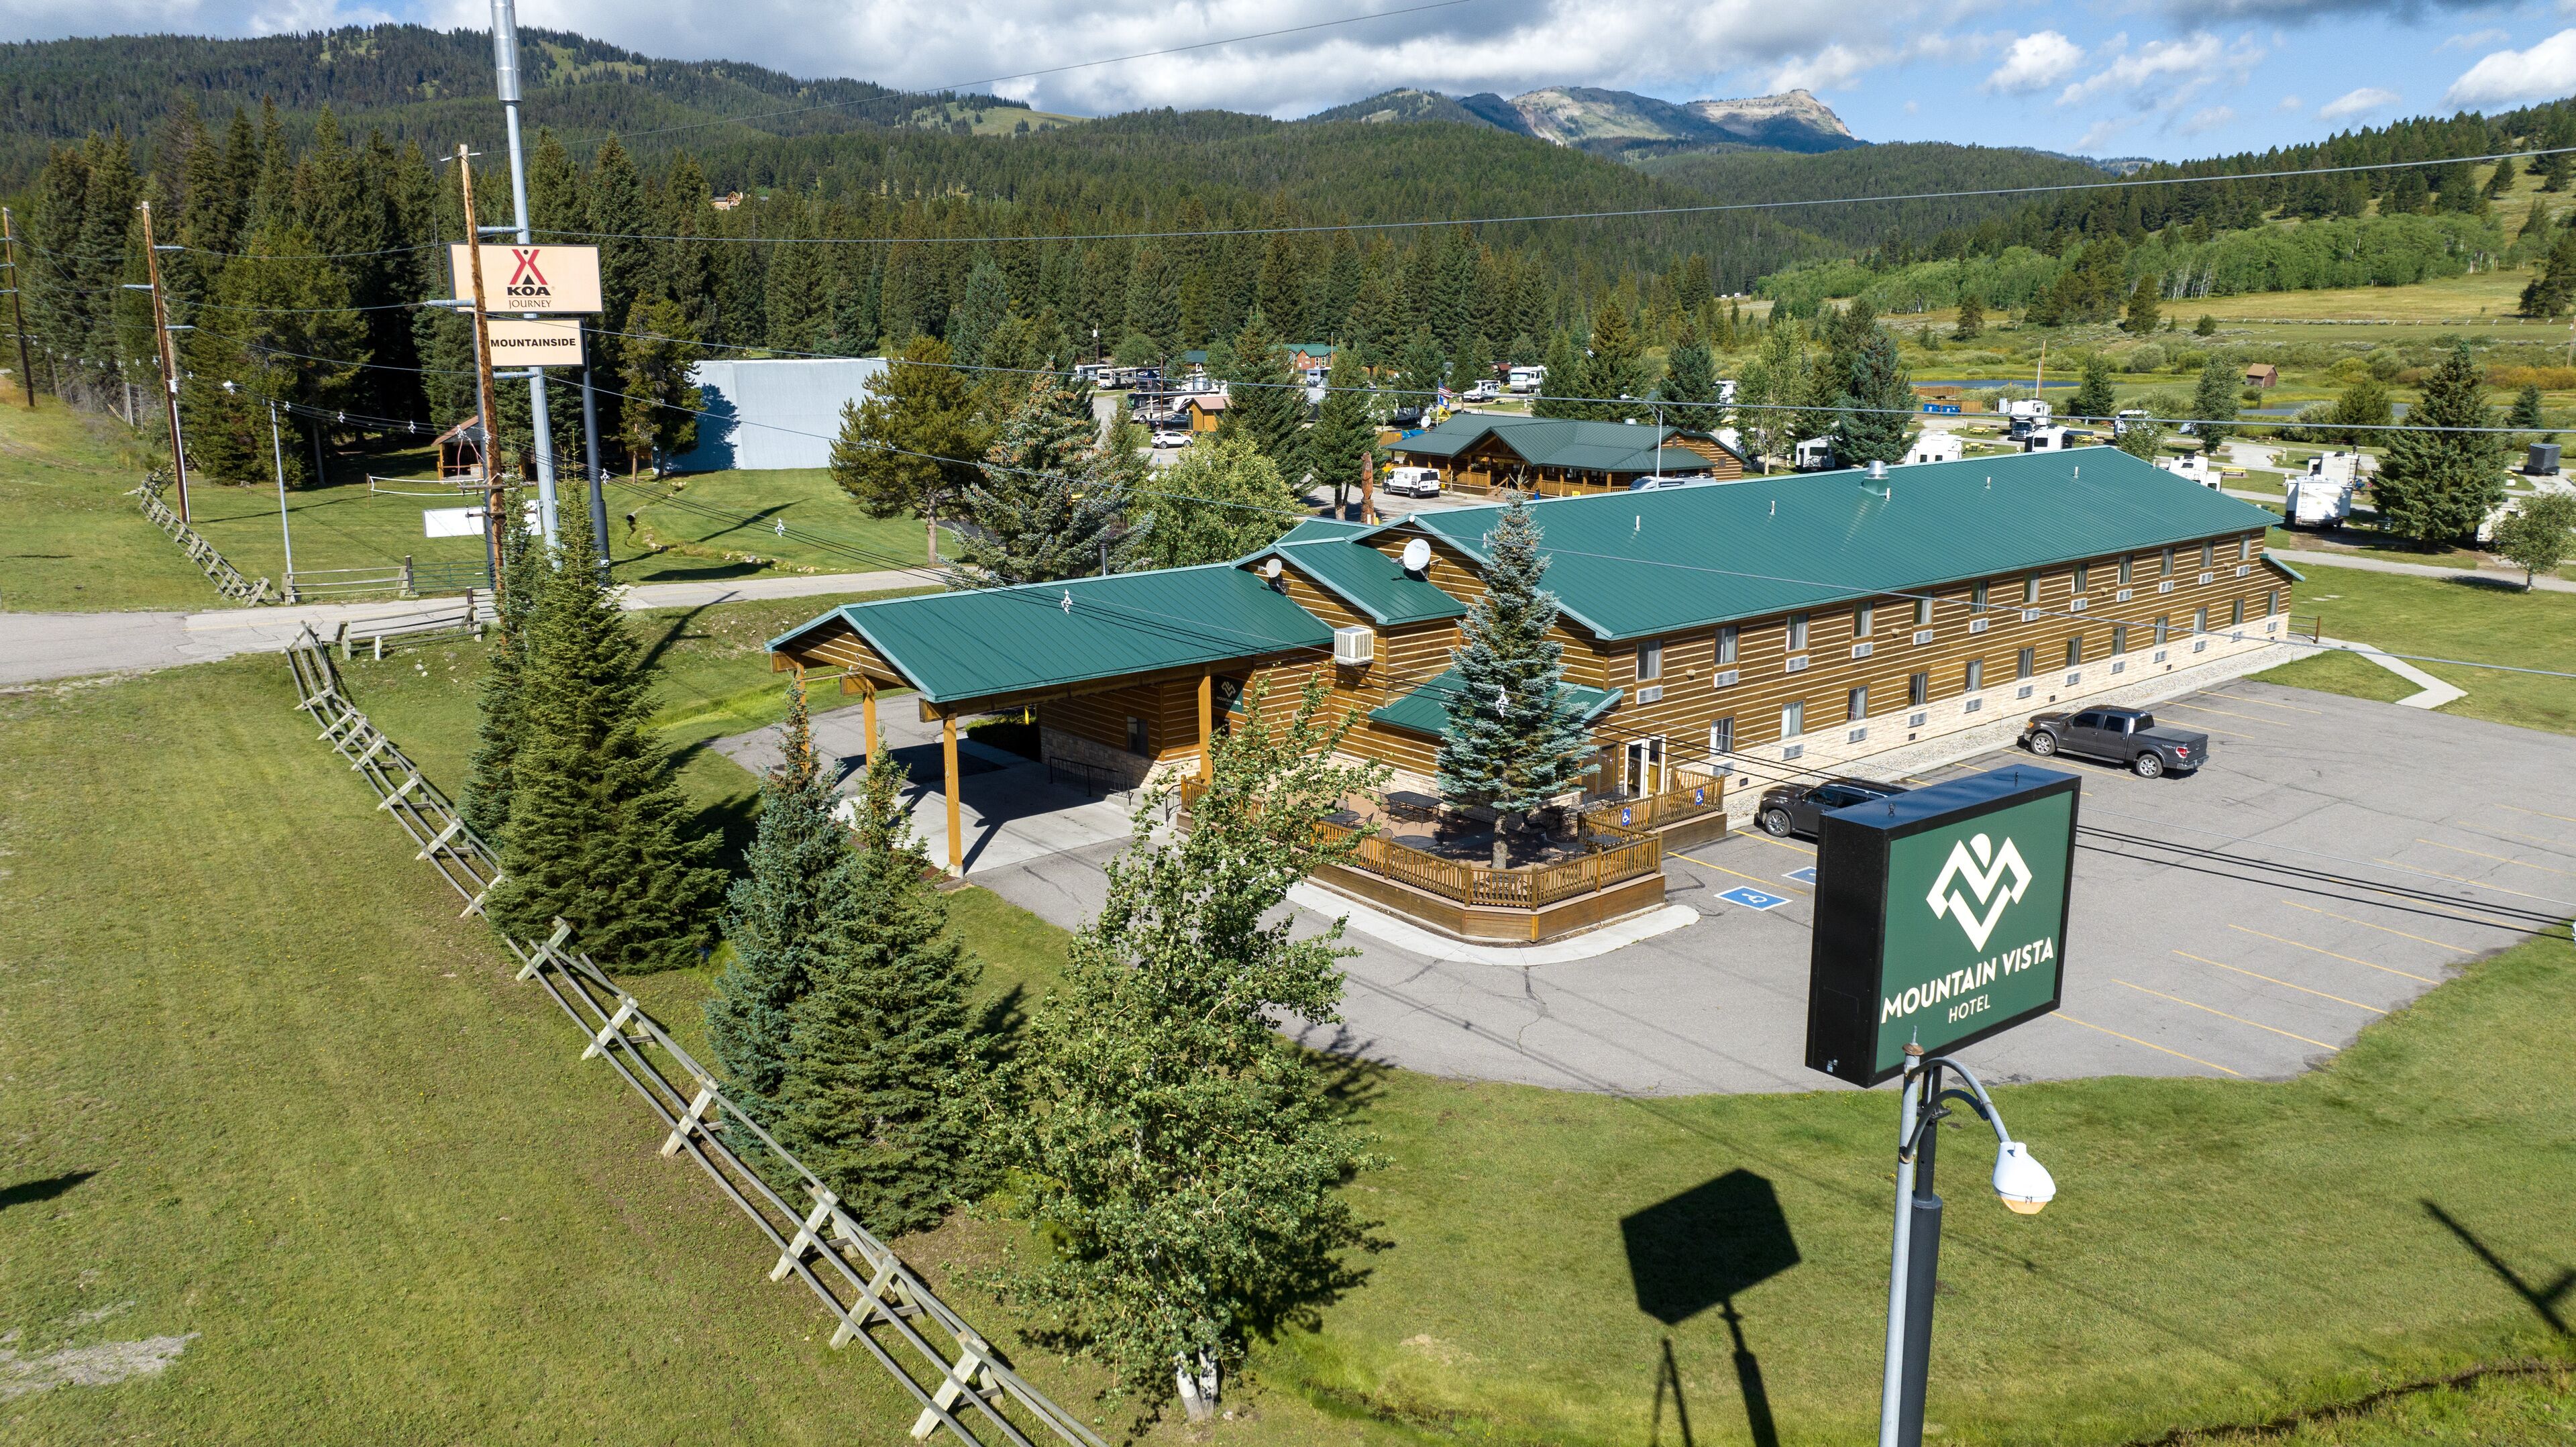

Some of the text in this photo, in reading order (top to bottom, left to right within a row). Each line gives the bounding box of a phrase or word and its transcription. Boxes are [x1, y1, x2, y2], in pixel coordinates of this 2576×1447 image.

[507, 286, 551, 296] KOA
[509, 299, 551, 309] JOURNEY
[490, 338, 576, 347] MOUNTAINSIDE
[1880, 936, 2053, 1024] MOUNTAIN VISTA
[1948, 994, 1990, 1024] HOTEL
